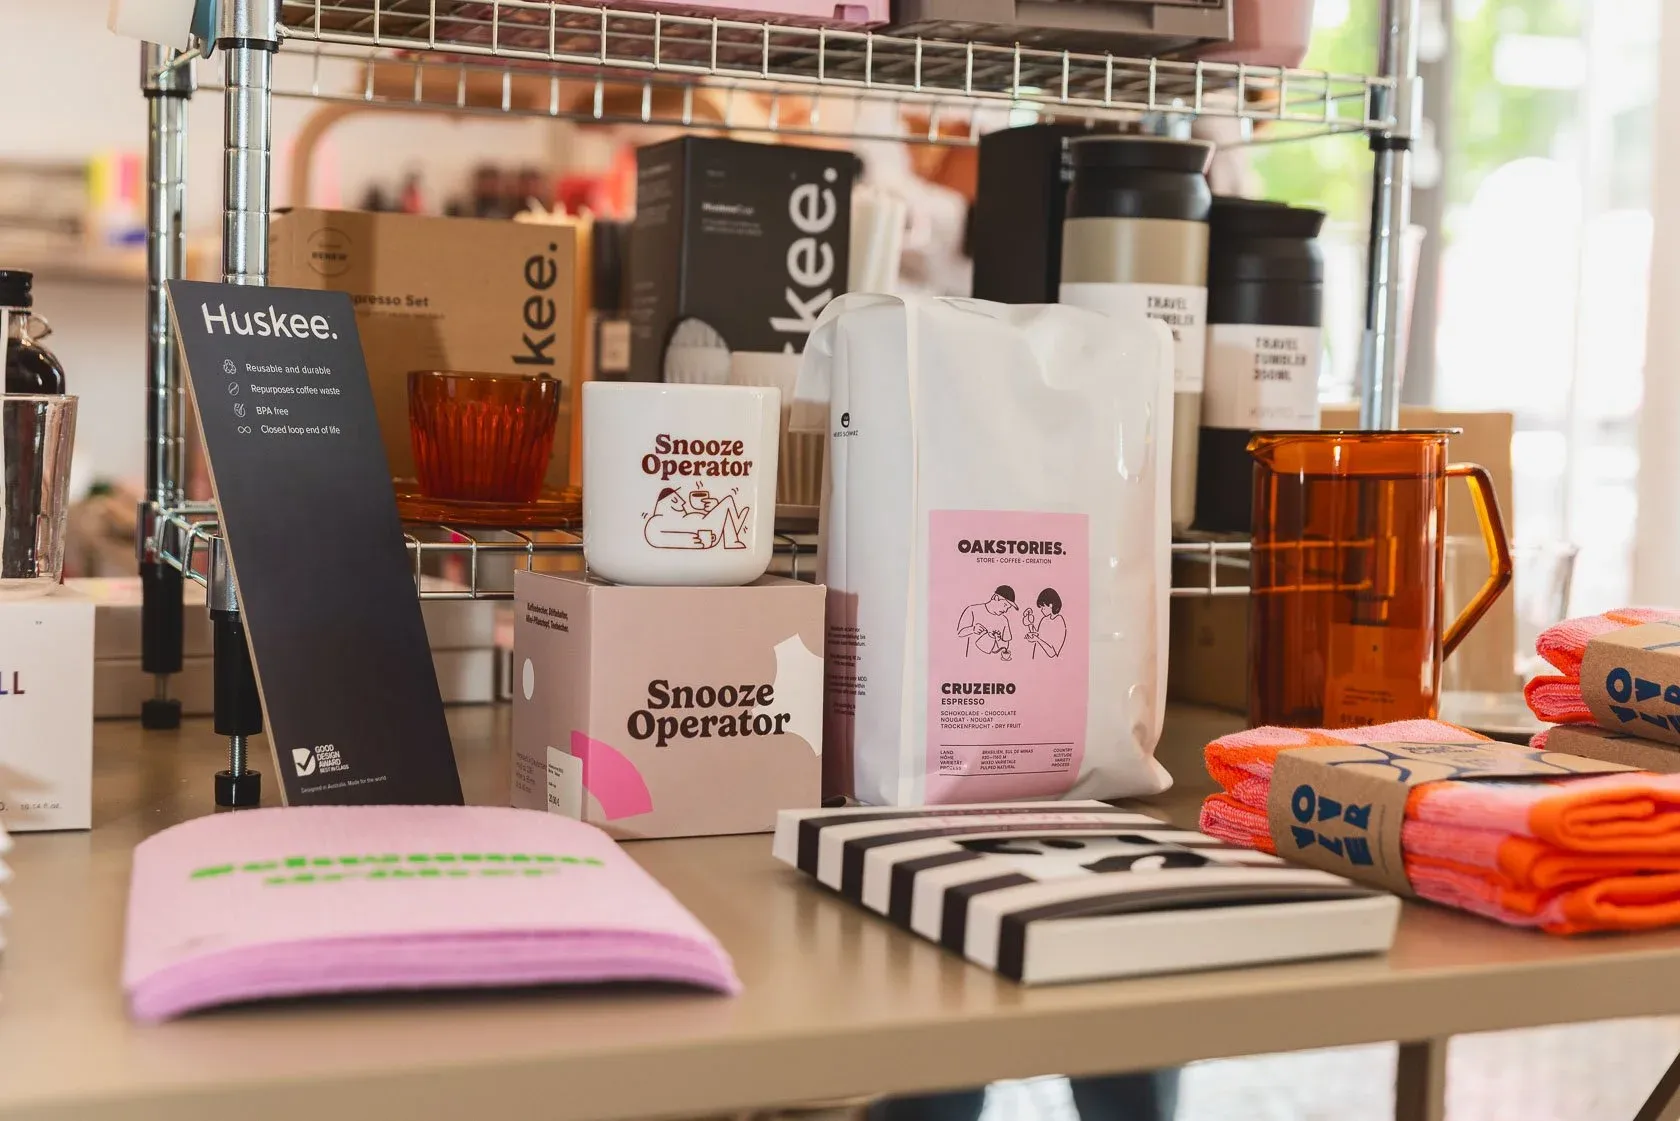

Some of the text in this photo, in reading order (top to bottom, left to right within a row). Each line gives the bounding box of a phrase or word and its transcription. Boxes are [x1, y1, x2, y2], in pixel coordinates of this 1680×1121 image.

[769, 167, 838, 354] kee.
[350, 294, 429, 307] presso Set
[1147, 295, 1188, 310] TRAVEL
[512, 242, 558, 378] kee.
[201, 302, 338, 340] Huskee.
[1255, 336, 1299, 350] TRAVEL
[1254, 352, 1307, 366] TUMBLER
[245, 363, 331, 374] Reusable and durable
[250, 384, 340, 395] Repurposes coffee waste
[256, 406, 289, 416] BPA free
[260, 424, 340, 435] Closed loop end of life
[655, 433, 744, 456] Snooze
[641, 453, 753, 481] Operator
[957, 539, 1067, 556] OAKSTORIES.
[647, 679, 775, 710] Snooze
[941, 682, 1016, 695] CRUZEIRO
[941, 698, 985, 706] ESPRESSO
[627, 709, 791, 748] Operator
[314, 743, 335, 754] GOOD
[316, 750, 341, 761] DESIGN
[319, 758, 341, 768] AWARD
[301, 785, 322, 794] Designed
